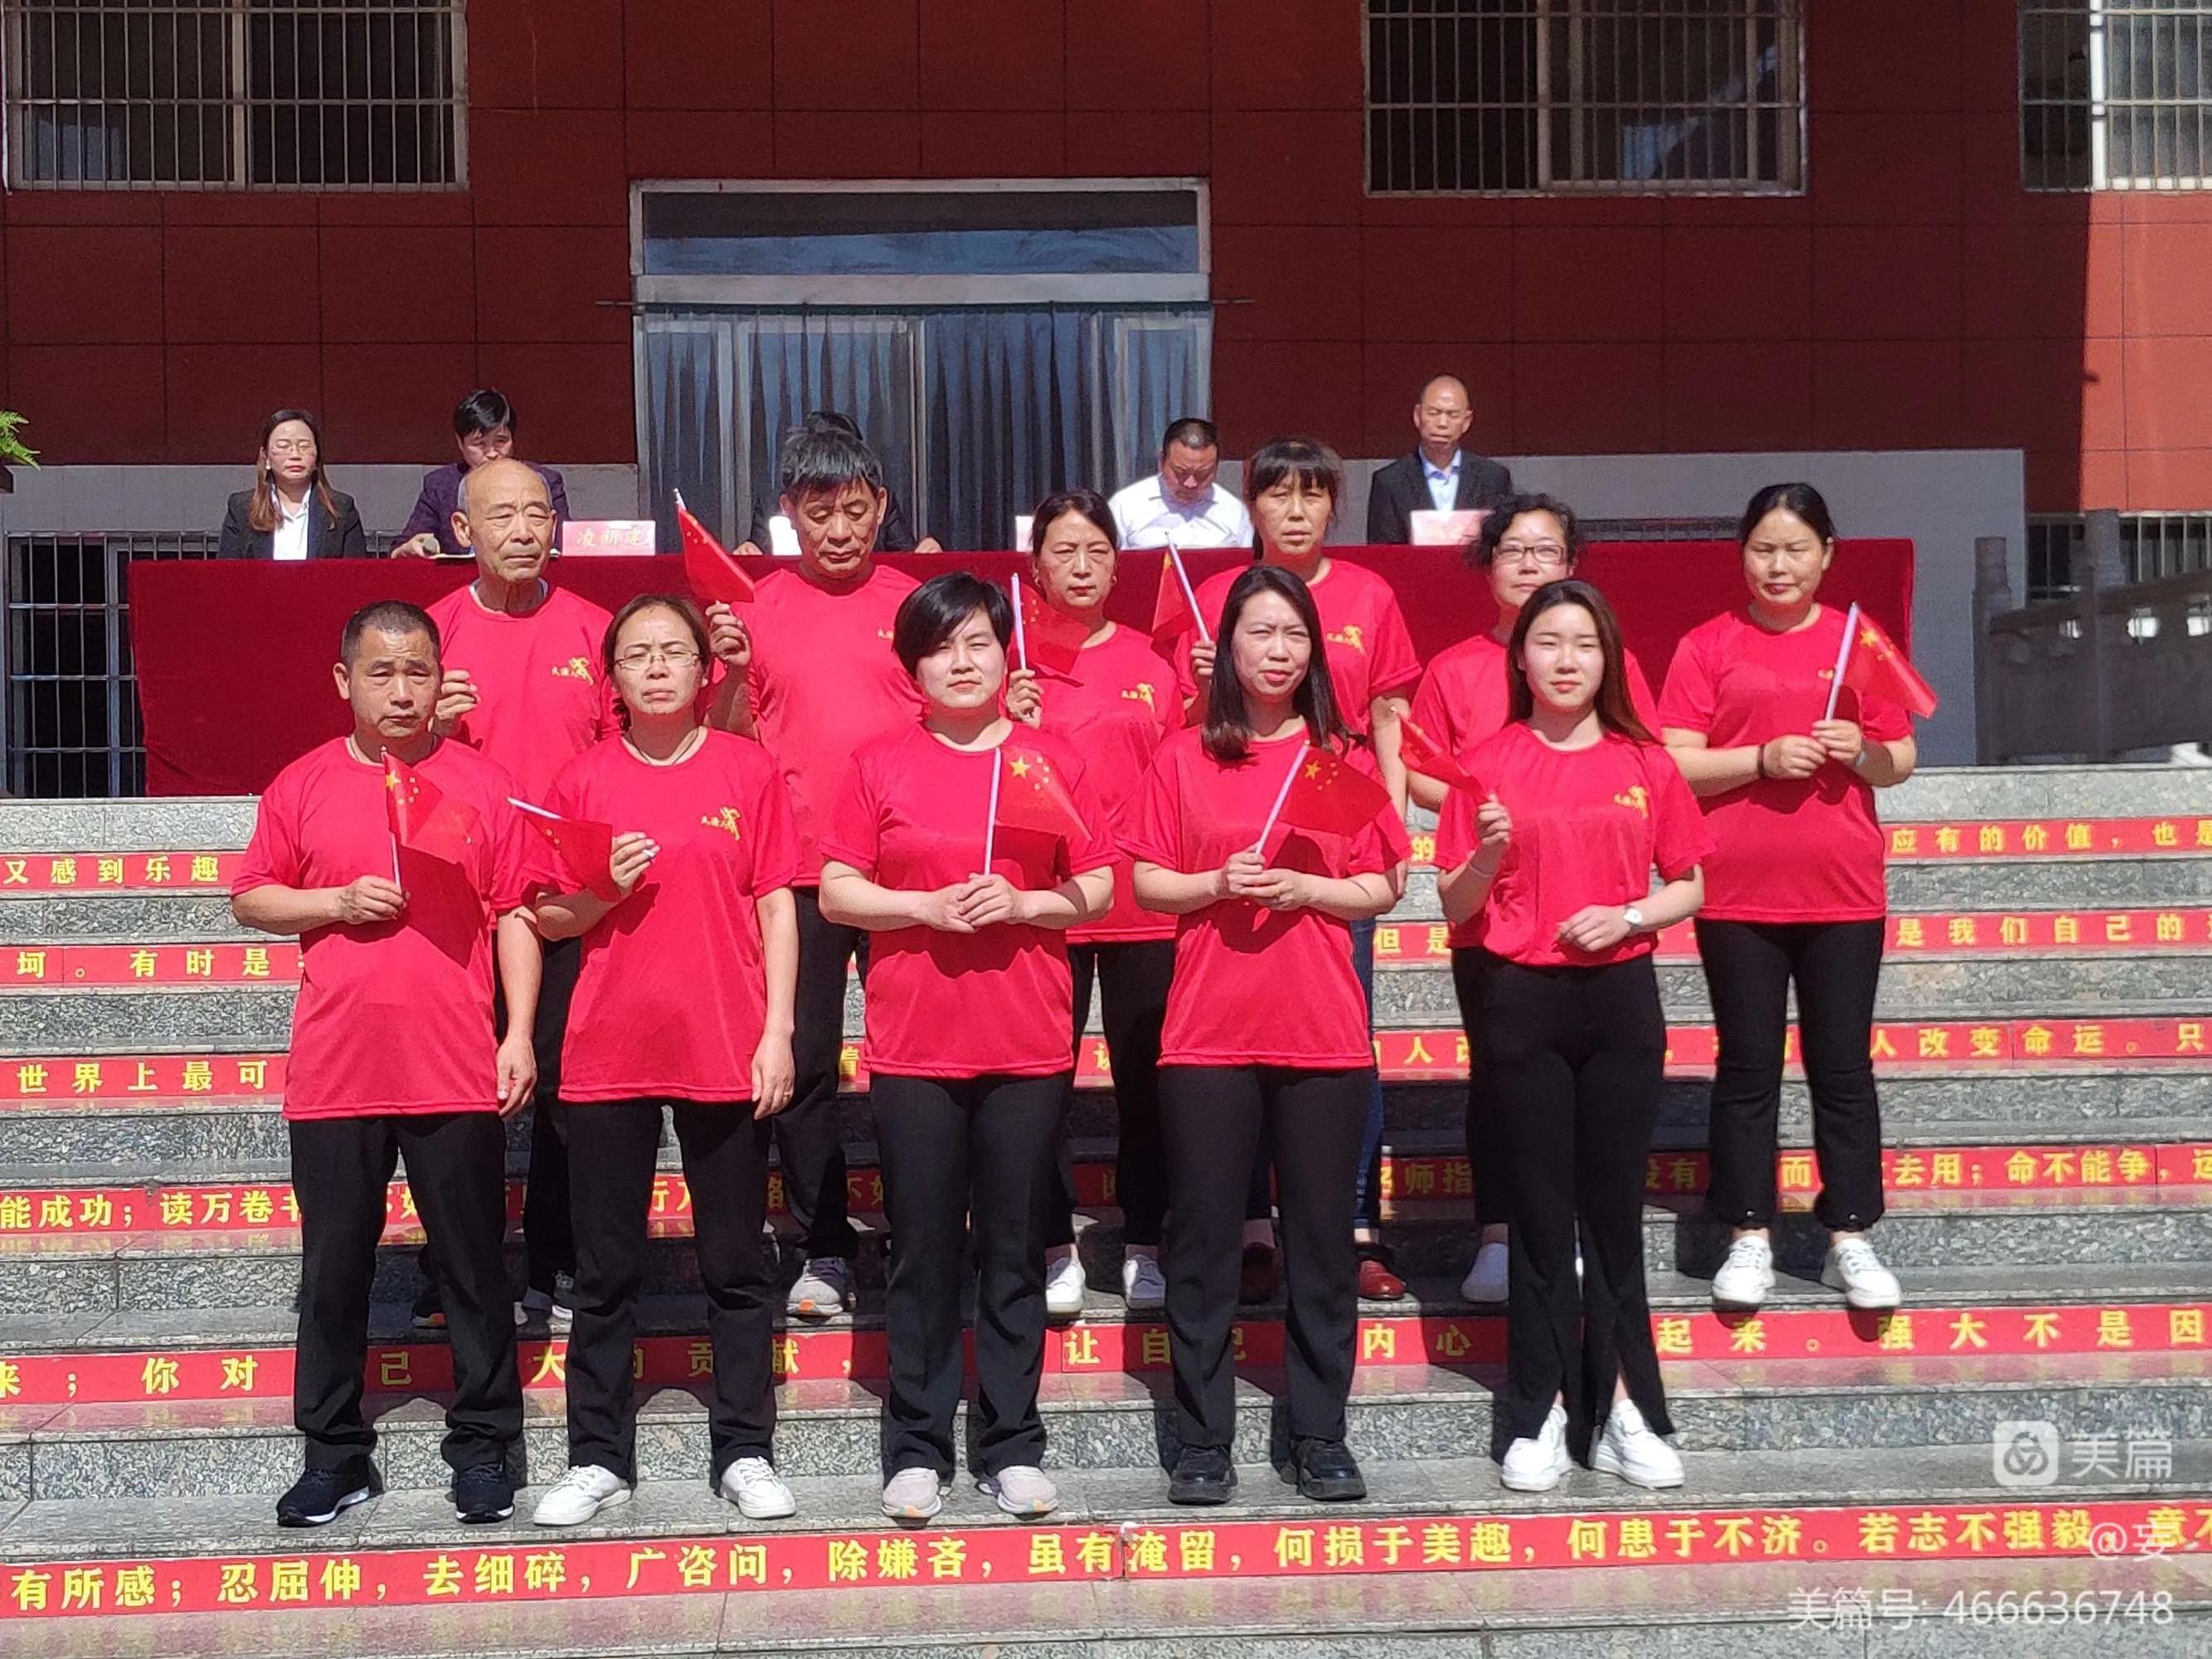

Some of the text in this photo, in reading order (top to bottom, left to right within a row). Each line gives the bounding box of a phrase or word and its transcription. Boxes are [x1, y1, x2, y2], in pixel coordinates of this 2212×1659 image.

[3, 855, 220, 884] 又感到乐趣
[1373, 927, 1451, 955] 但是
[1897, 914, 2212, 947] 是我们自己的
[17, 948, 304, 980] 坷。有时是
[1870, 1021, 2205, 1058] 人改变命运。只
[17, 1060, 266, 1093] 世界上最可
[1780, 1155, 1813, 1187] 而
[1881, 1147, 2212, 1186] 去用；命不能争，运
[1363, 1322, 1471, 1360] 内心
